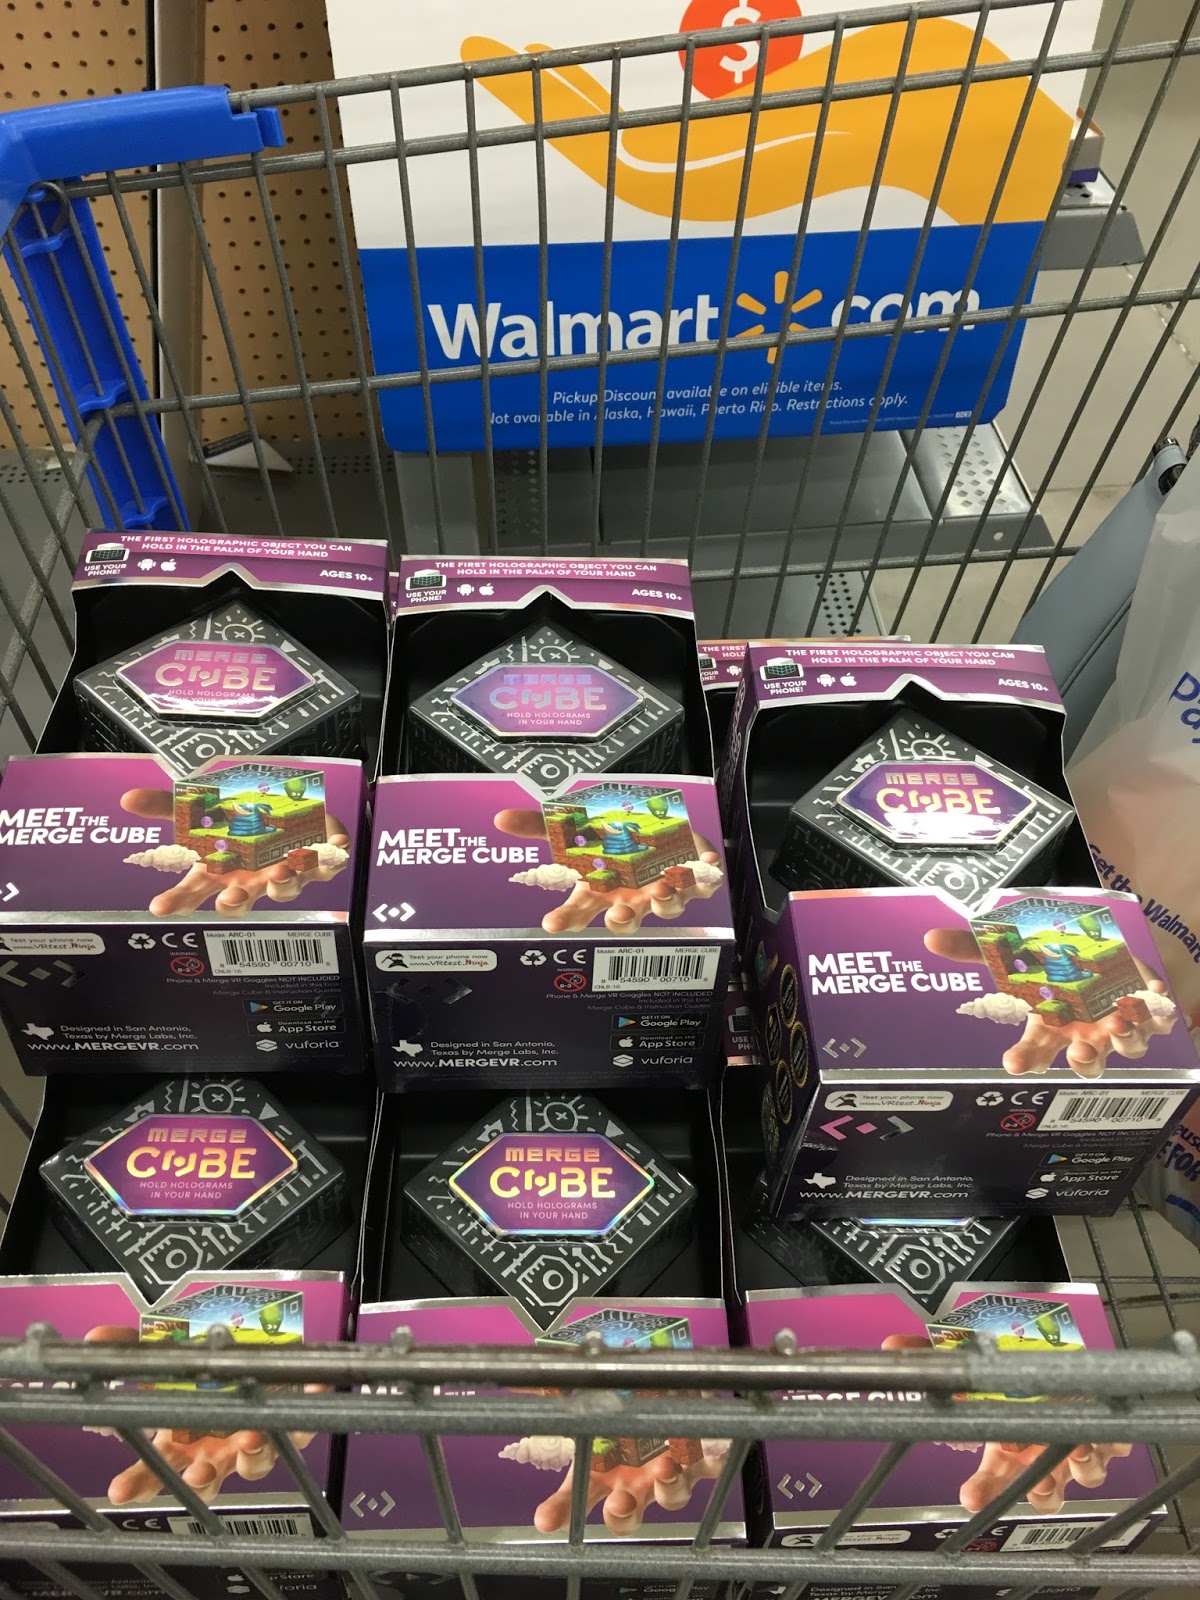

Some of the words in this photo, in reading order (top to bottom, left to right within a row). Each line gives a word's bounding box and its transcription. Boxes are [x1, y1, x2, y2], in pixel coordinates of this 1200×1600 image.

[428, 294, 719, 360] Walmart
[553, 391, 598, 406] Pickup
[603, 390, 658, 402] Discoun
[731, 386, 748, 396] on
[752, 381, 800, 396] eliible
[514, 411, 574, 423] avaiable
[579, 409, 590, 421] in
[594, 407, 642, 421] laska,
[787, 396, 864, 411] Restrctions
[177, 537, 259, 547] HOLOGRAPHIC
[320, 570, 352, 579] AGES
[355, 573, 373, 582] 10+
[411, 595, 442, 603] PHONE!
[632, 588, 662, 598] AGES
[665, 592, 682, 600] 10+
[174, 650, 267, 664] MERGE
[841, 649, 922, 657] HOLOGRAPHIC
[155, 663, 276, 691] CUBE
[503, 674, 592, 684] MERGE
[770, 686, 803, 695] PHONE!
[998, 678, 1030, 689] AGES
[1030, 682, 1048, 692] 10+
[489, 687, 607, 710] CUBE
[885, 772, 978, 785] MERGE
[876, 788, 1001, 814] CUBE
[0, 807, 84, 828] MEET
[79, 816, 109, 826] THE
[90, 827, 161, 844] CUBE
[378, 828, 461, 849] MEET
[458, 836, 487, 847] THE
[377, 847, 467, 866] MERGE
[472, 847, 539, 864] CUBE
[808, 951, 892, 976] MEET
[892, 960, 923, 973] THE
[811, 974, 907, 996] MERGE
[911, 972, 983, 992] CUBE
[273, 1004, 313, 1013] Google
[315, 1002, 336, 1012] Play
[279, 1024, 303, 1034] App
[305, 1024, 337, 1032] Store
[640, 1019, 678, 1028] Google
[680, 1019, 701, 1027] Play
[28, 1041, 199, 1051] www.MERGEVR.com
[285, 1040, 339, 1049] vuforia
[639, 1040, 663, 1049] App
[665, 1039, 696, 1047] Store
[462, 1049, 474, 1057] by
[477, 1049, 510, 1057] Merge
[393, 1058, 557, 1067] www.MERGEVR.com
[641, 1057, 693, 1065] vuforia
[147, 1128, 247, 1143] MERGE
[505, 1147, 600, 1162] MERGE
[1071, 1156, 1111, 1164] Google
[1112, 1155, 1135, 1163] Play
[126, 1146, 257, 1179] CUBE
[490, 1166, 615, 1198] CUBE
[1060, 1175, 1087, 1183] App
[140, 1181, 167, 1189] HOLD
[165, 1191, 192, 1199] YOUR
[800, 1190, 969, 1199] www.MERGEVR.com
[1055, 1188, 1110, 1197] vuforia
[537, 1202, 598, 1210] HOLOGRAMS
[520, 1211, 530, 1219] IN
[562, 1212, 589, 1220] HAND
